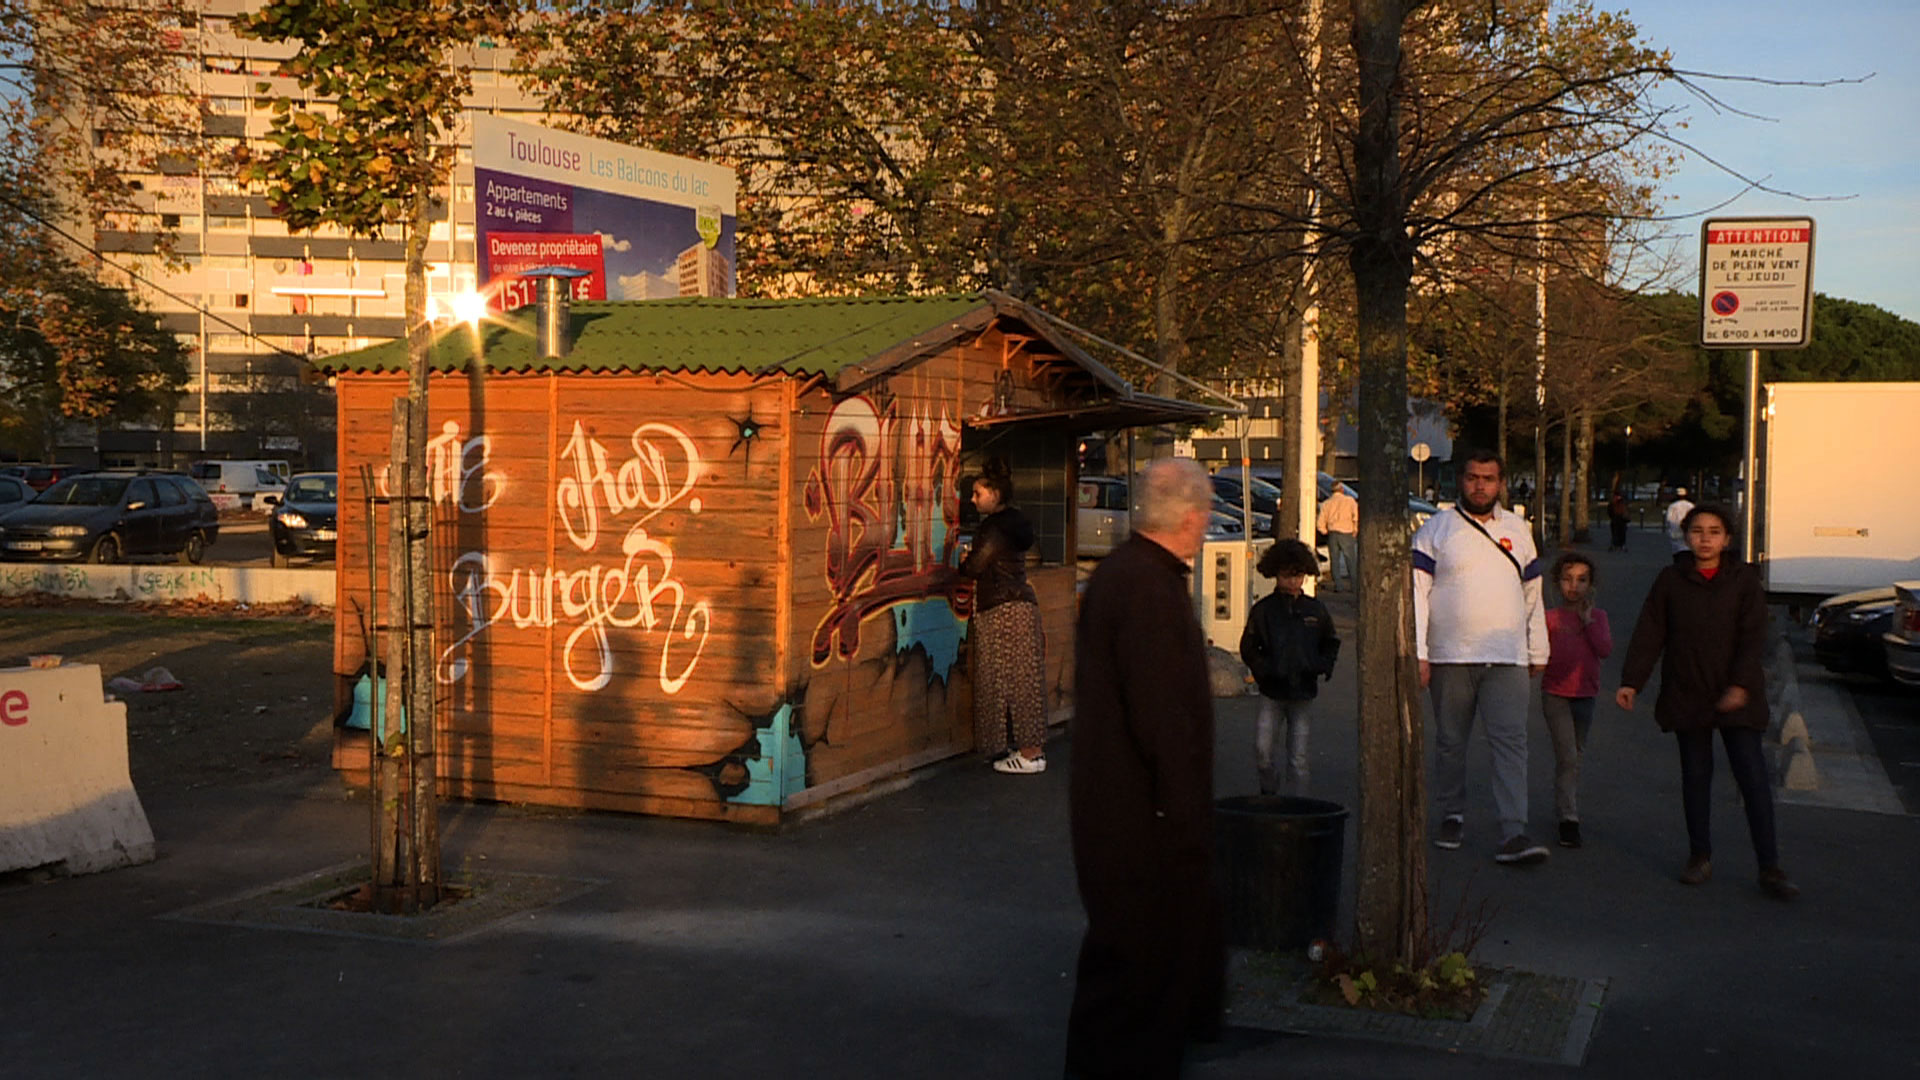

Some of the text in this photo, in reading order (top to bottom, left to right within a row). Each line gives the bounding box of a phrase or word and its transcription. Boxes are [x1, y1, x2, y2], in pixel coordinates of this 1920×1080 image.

[508, 132, 709, 197] Toulouse Les Balcons du lac
[486, 180, 568, 211] Appartements
[486, 202, 542, 223] 2 au 4 pièces
[1716, 229, 1800, 243] ATTENTION
[491, 238, 598, 259] Devenez propriétaire
[1730, 247, 1783, 258] MARCHÉ
[1712, 260, 1800, 271] DE PLEIN VENT
[1726, 272, 1785, 282] LE JEUDI
